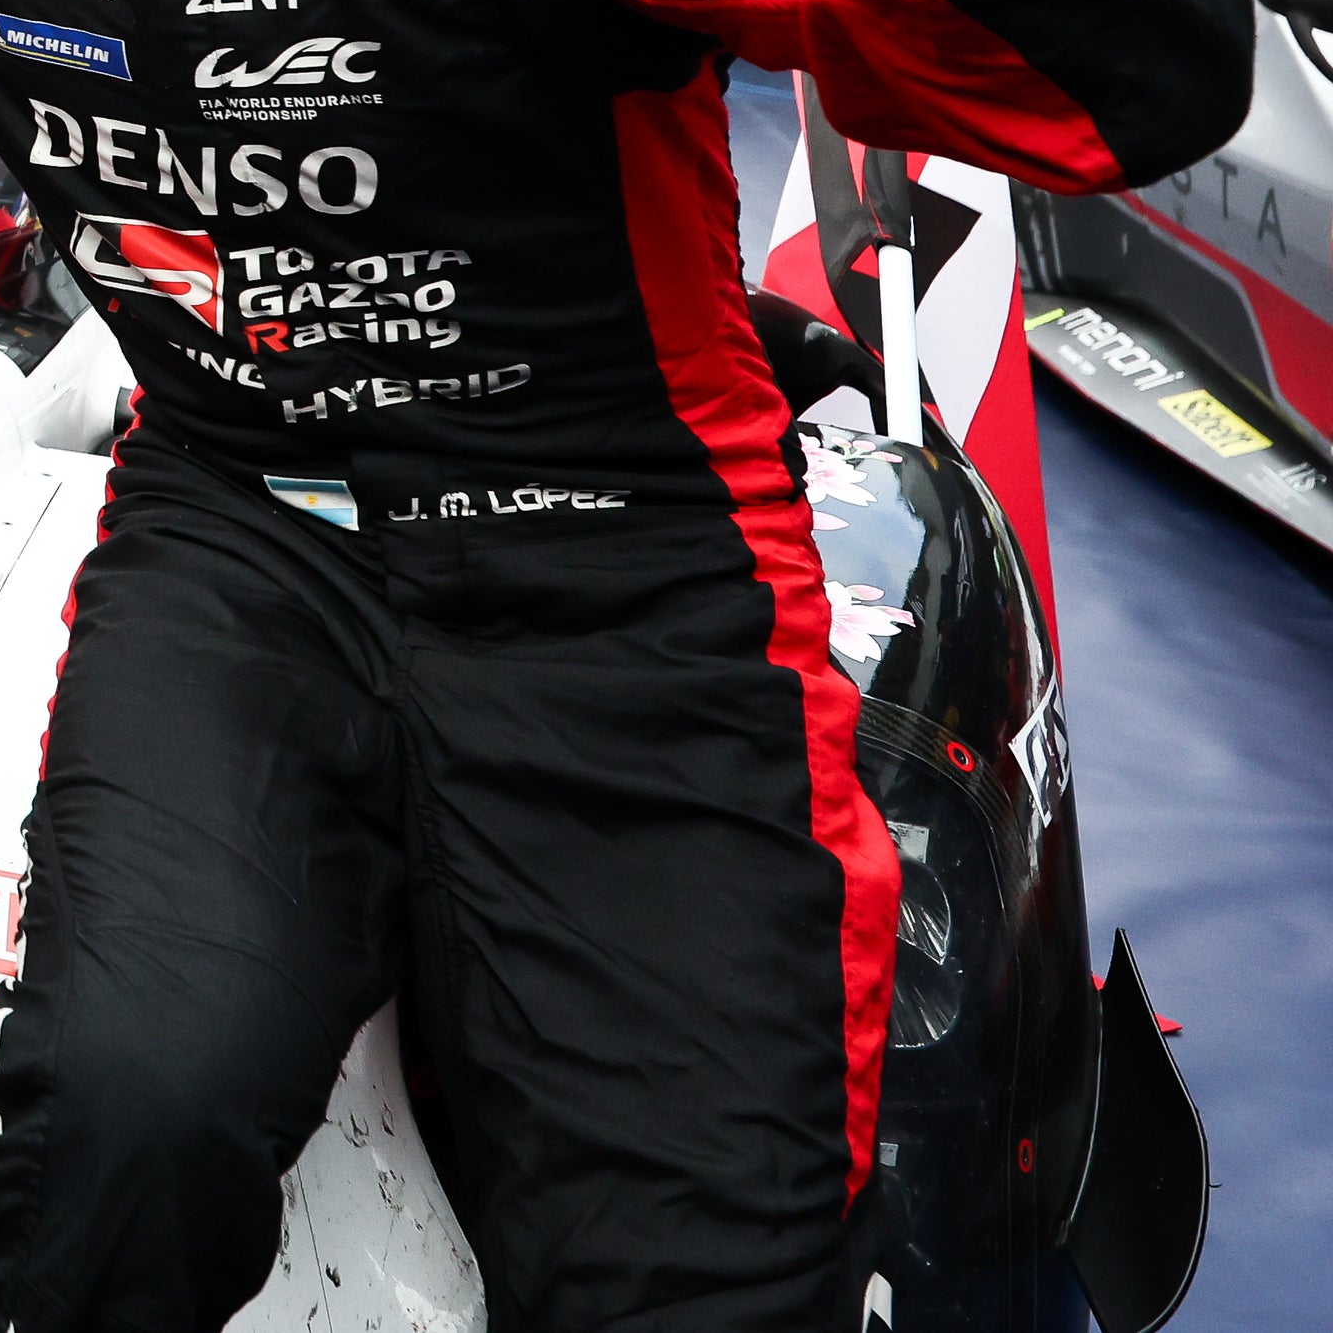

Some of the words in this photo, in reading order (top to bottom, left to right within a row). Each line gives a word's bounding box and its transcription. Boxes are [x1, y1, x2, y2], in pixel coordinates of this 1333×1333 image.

[6, 28, 110, 64] MICHELIN
[195, 37, 382, 88] WEC
[199, 98, 224, 110] FIA
[227, 97, 281, 109] WORLD
[284, 93, 384, 108] ENDURANCE
[203, 108, 319, 121] CHAMPIONSHIP
[30, 98, 379, 217] DENSO
[229, 246, 472, 284] TOOTA
[240, 312, 461, 354] Racing
[283, 362, 532, 423] HYBRID
[388, 496, 428, 523] J.
[439, 493, 478, 519] M.
[487, 483, 633, 514] LÓPEZ
